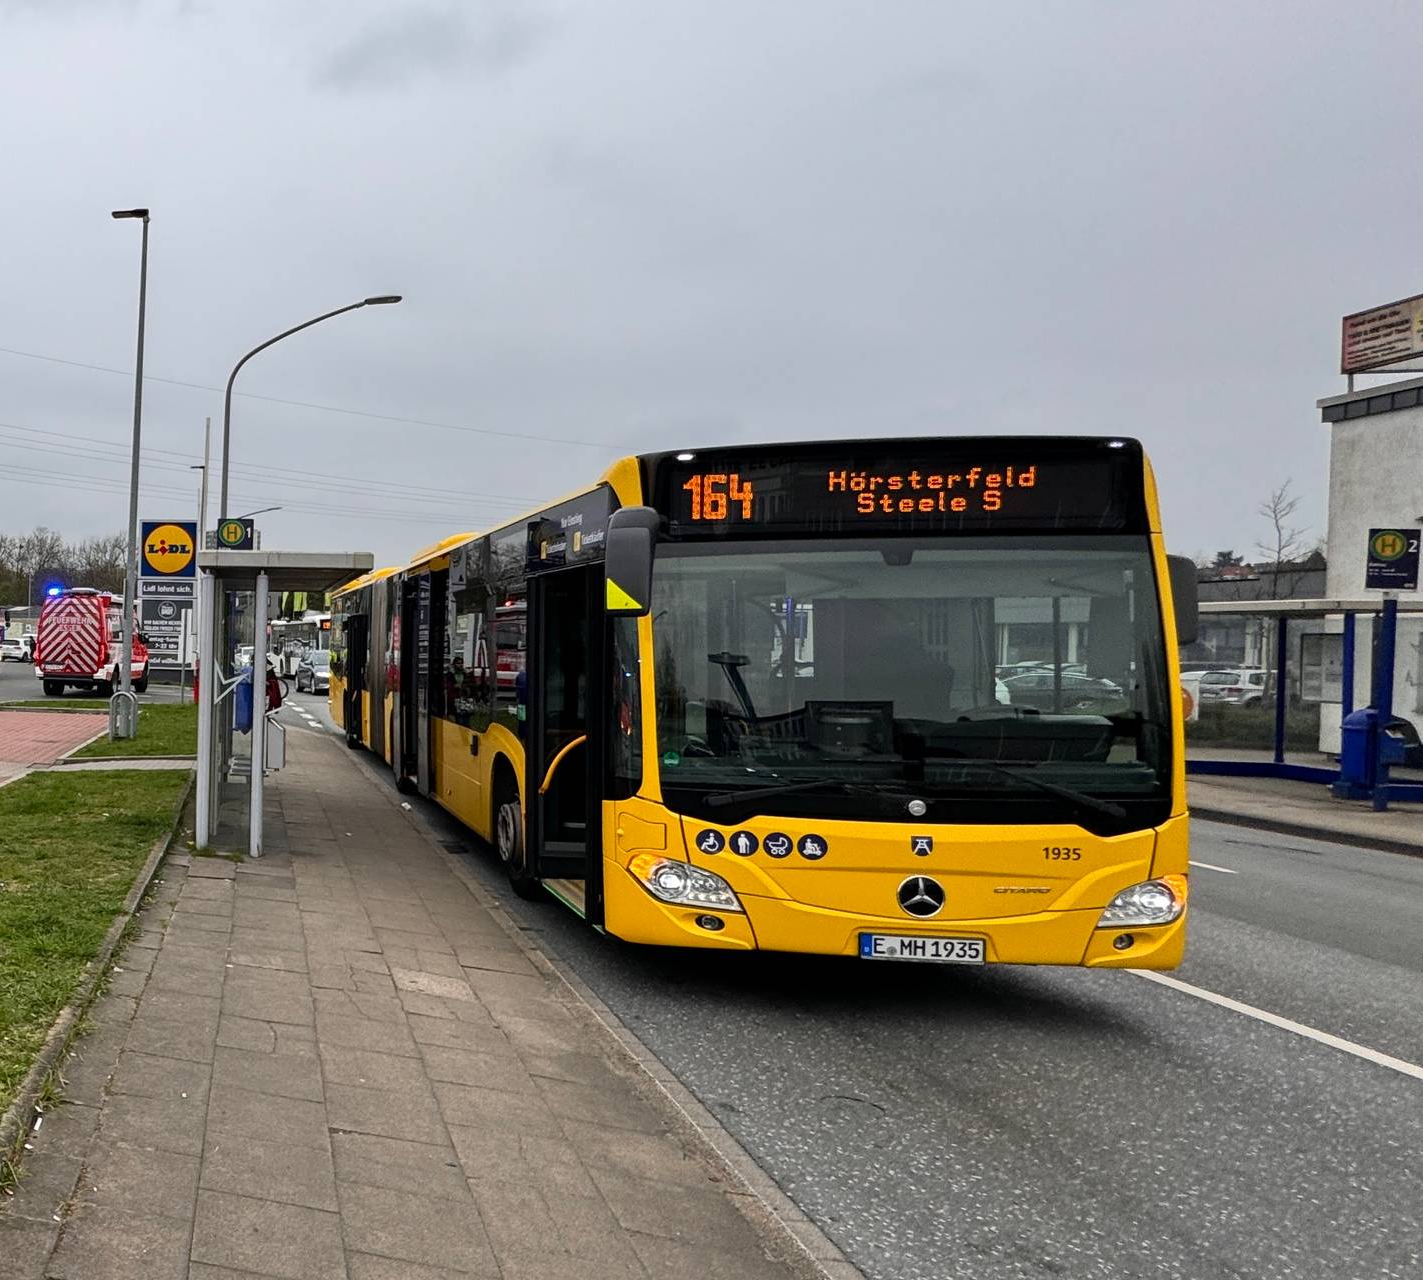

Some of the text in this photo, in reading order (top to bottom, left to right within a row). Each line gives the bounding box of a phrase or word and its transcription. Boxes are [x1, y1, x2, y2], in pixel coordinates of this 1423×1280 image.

[683, 466, 1037, 520] 164 Hörsterfeld
[857, 490, 1002, 514] Steele S
[227, 522, 251, 540] H 1
[1381, 536, 1418, 553] H 2
[1042, 846, 1082, 861] 1935
[873, 937, 886, 955] E
[900, 939, 926, 957] MH
[930, 940, 981, 959] 1935
